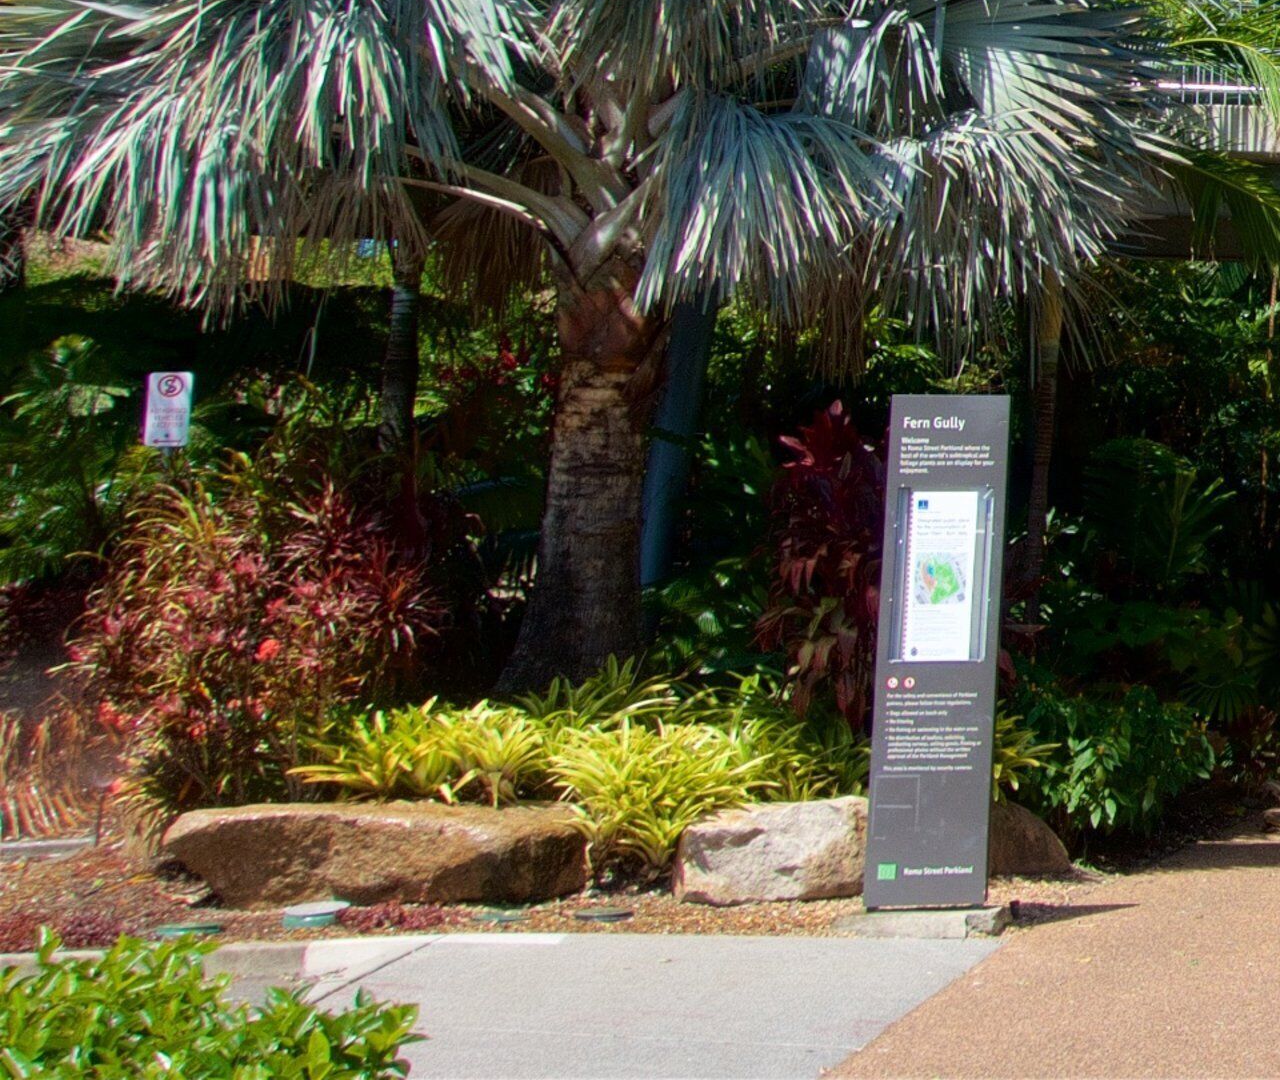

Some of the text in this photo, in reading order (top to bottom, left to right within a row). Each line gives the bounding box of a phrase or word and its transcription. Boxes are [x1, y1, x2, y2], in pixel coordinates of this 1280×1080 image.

[903, 416, 965, 431] Fern Gully
[903, 865, 973, 875] Roma Street Parkland
